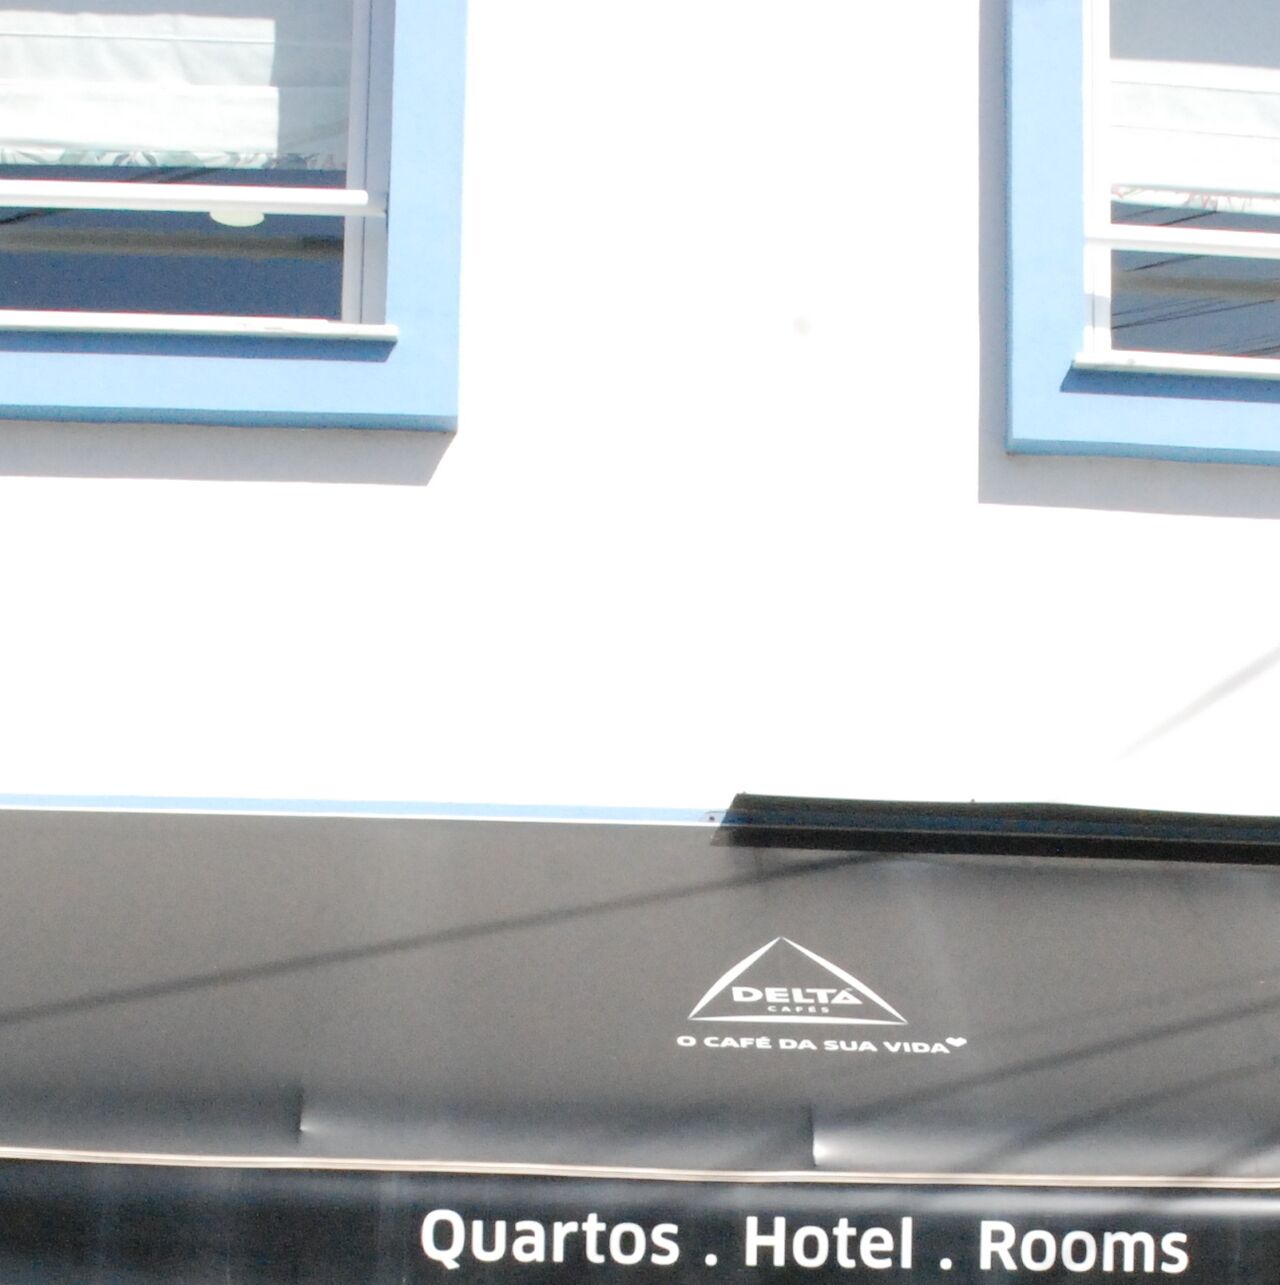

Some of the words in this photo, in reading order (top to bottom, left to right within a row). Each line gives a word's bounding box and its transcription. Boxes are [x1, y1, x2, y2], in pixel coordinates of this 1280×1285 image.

[731, 986, 863, 1005] DELTA
[767, 1005, 830, 1014] CAFÉS
[676, 1035, 697, 1047] O
[704, 1036, 773, 1050] CAFÉ
[778, 1038, 818, 1051] DA
[824, 1039, 878, 1053] SUA
[883, 1041, 951, 1055] VIDA
[421, 1209, 679, 1269] Quartos
[746, 1216, 912, 1269] Hotel
[980, 1220, 1188, 1273] Rooms
